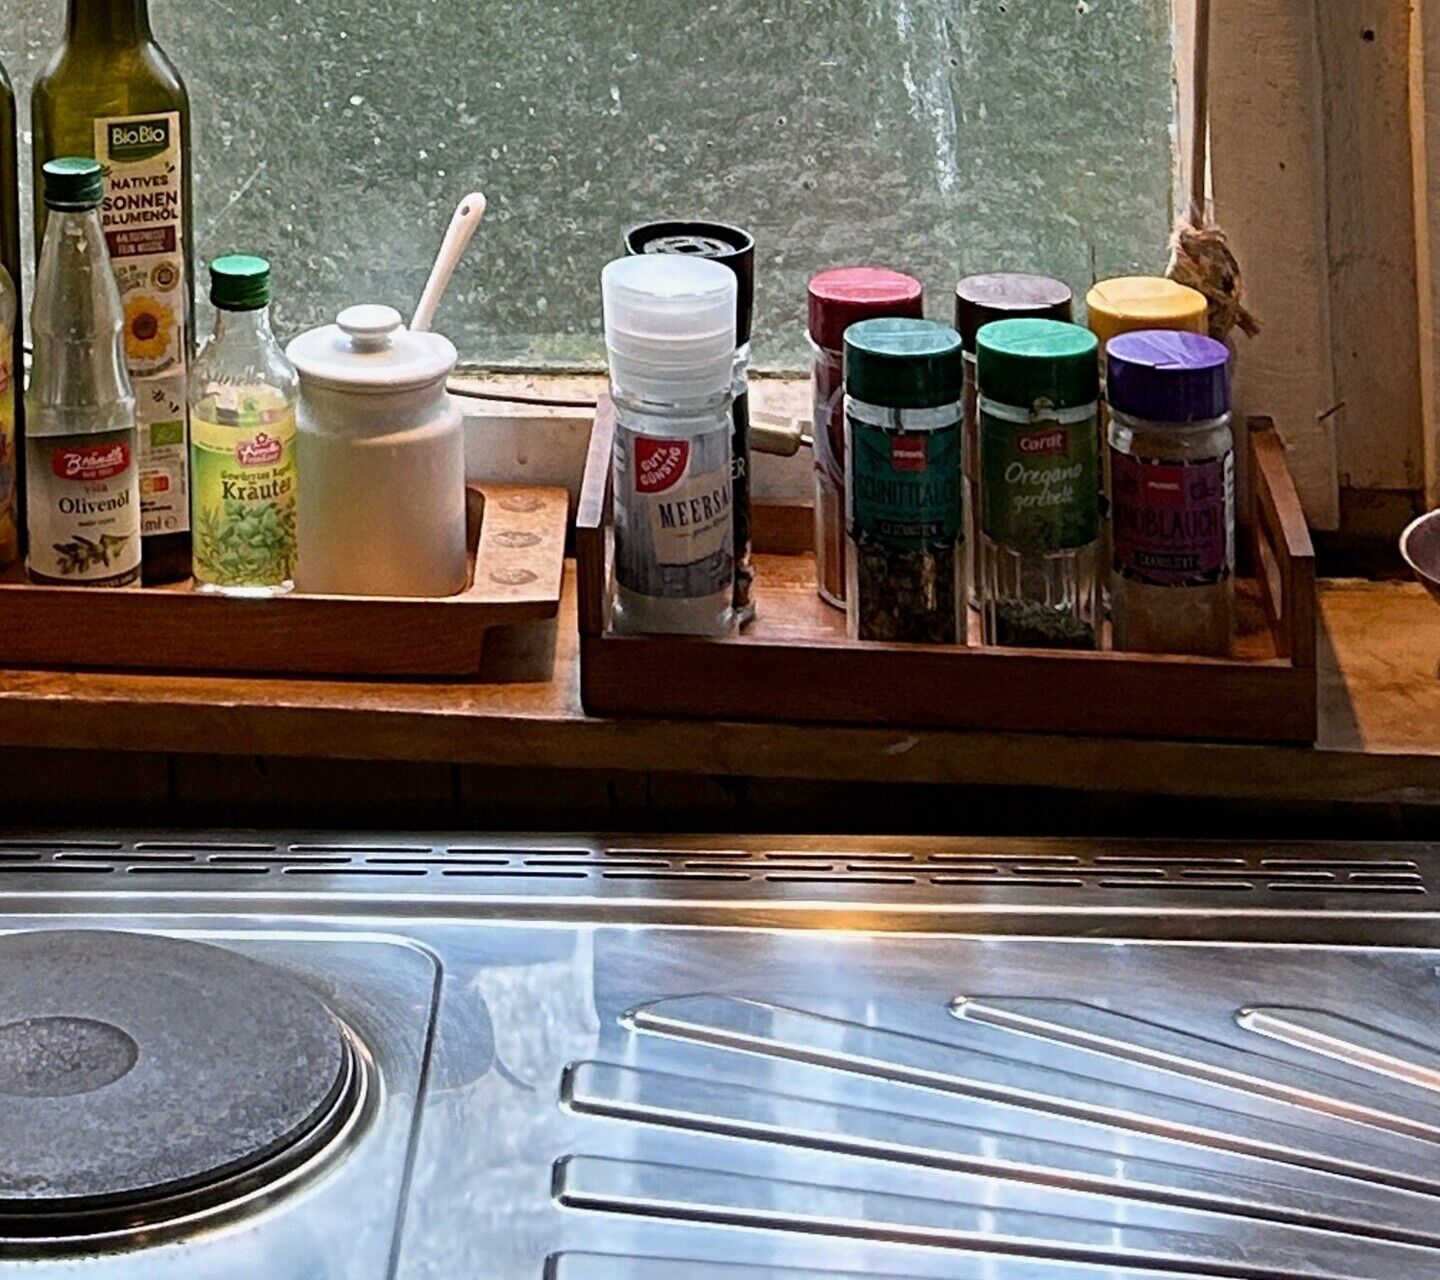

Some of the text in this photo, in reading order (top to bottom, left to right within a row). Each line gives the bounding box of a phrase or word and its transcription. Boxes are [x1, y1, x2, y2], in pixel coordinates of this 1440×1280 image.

[112, 125, 166, 145] BioBio
[111, 174, 169, 190] NATIVES
[102, 191, 178, 212] SONNEN
[102, 205, 179, 226] BLUMENÖL
[1020, 433, 1063, 451] Carat
[640, 446, 682, 486] GÜNSTIG
[1004, 462, 1082, 494] Oregano
[58, 489, 130, 514] Olivenöl
[1013, 485, 1073, 514] gerebelt
